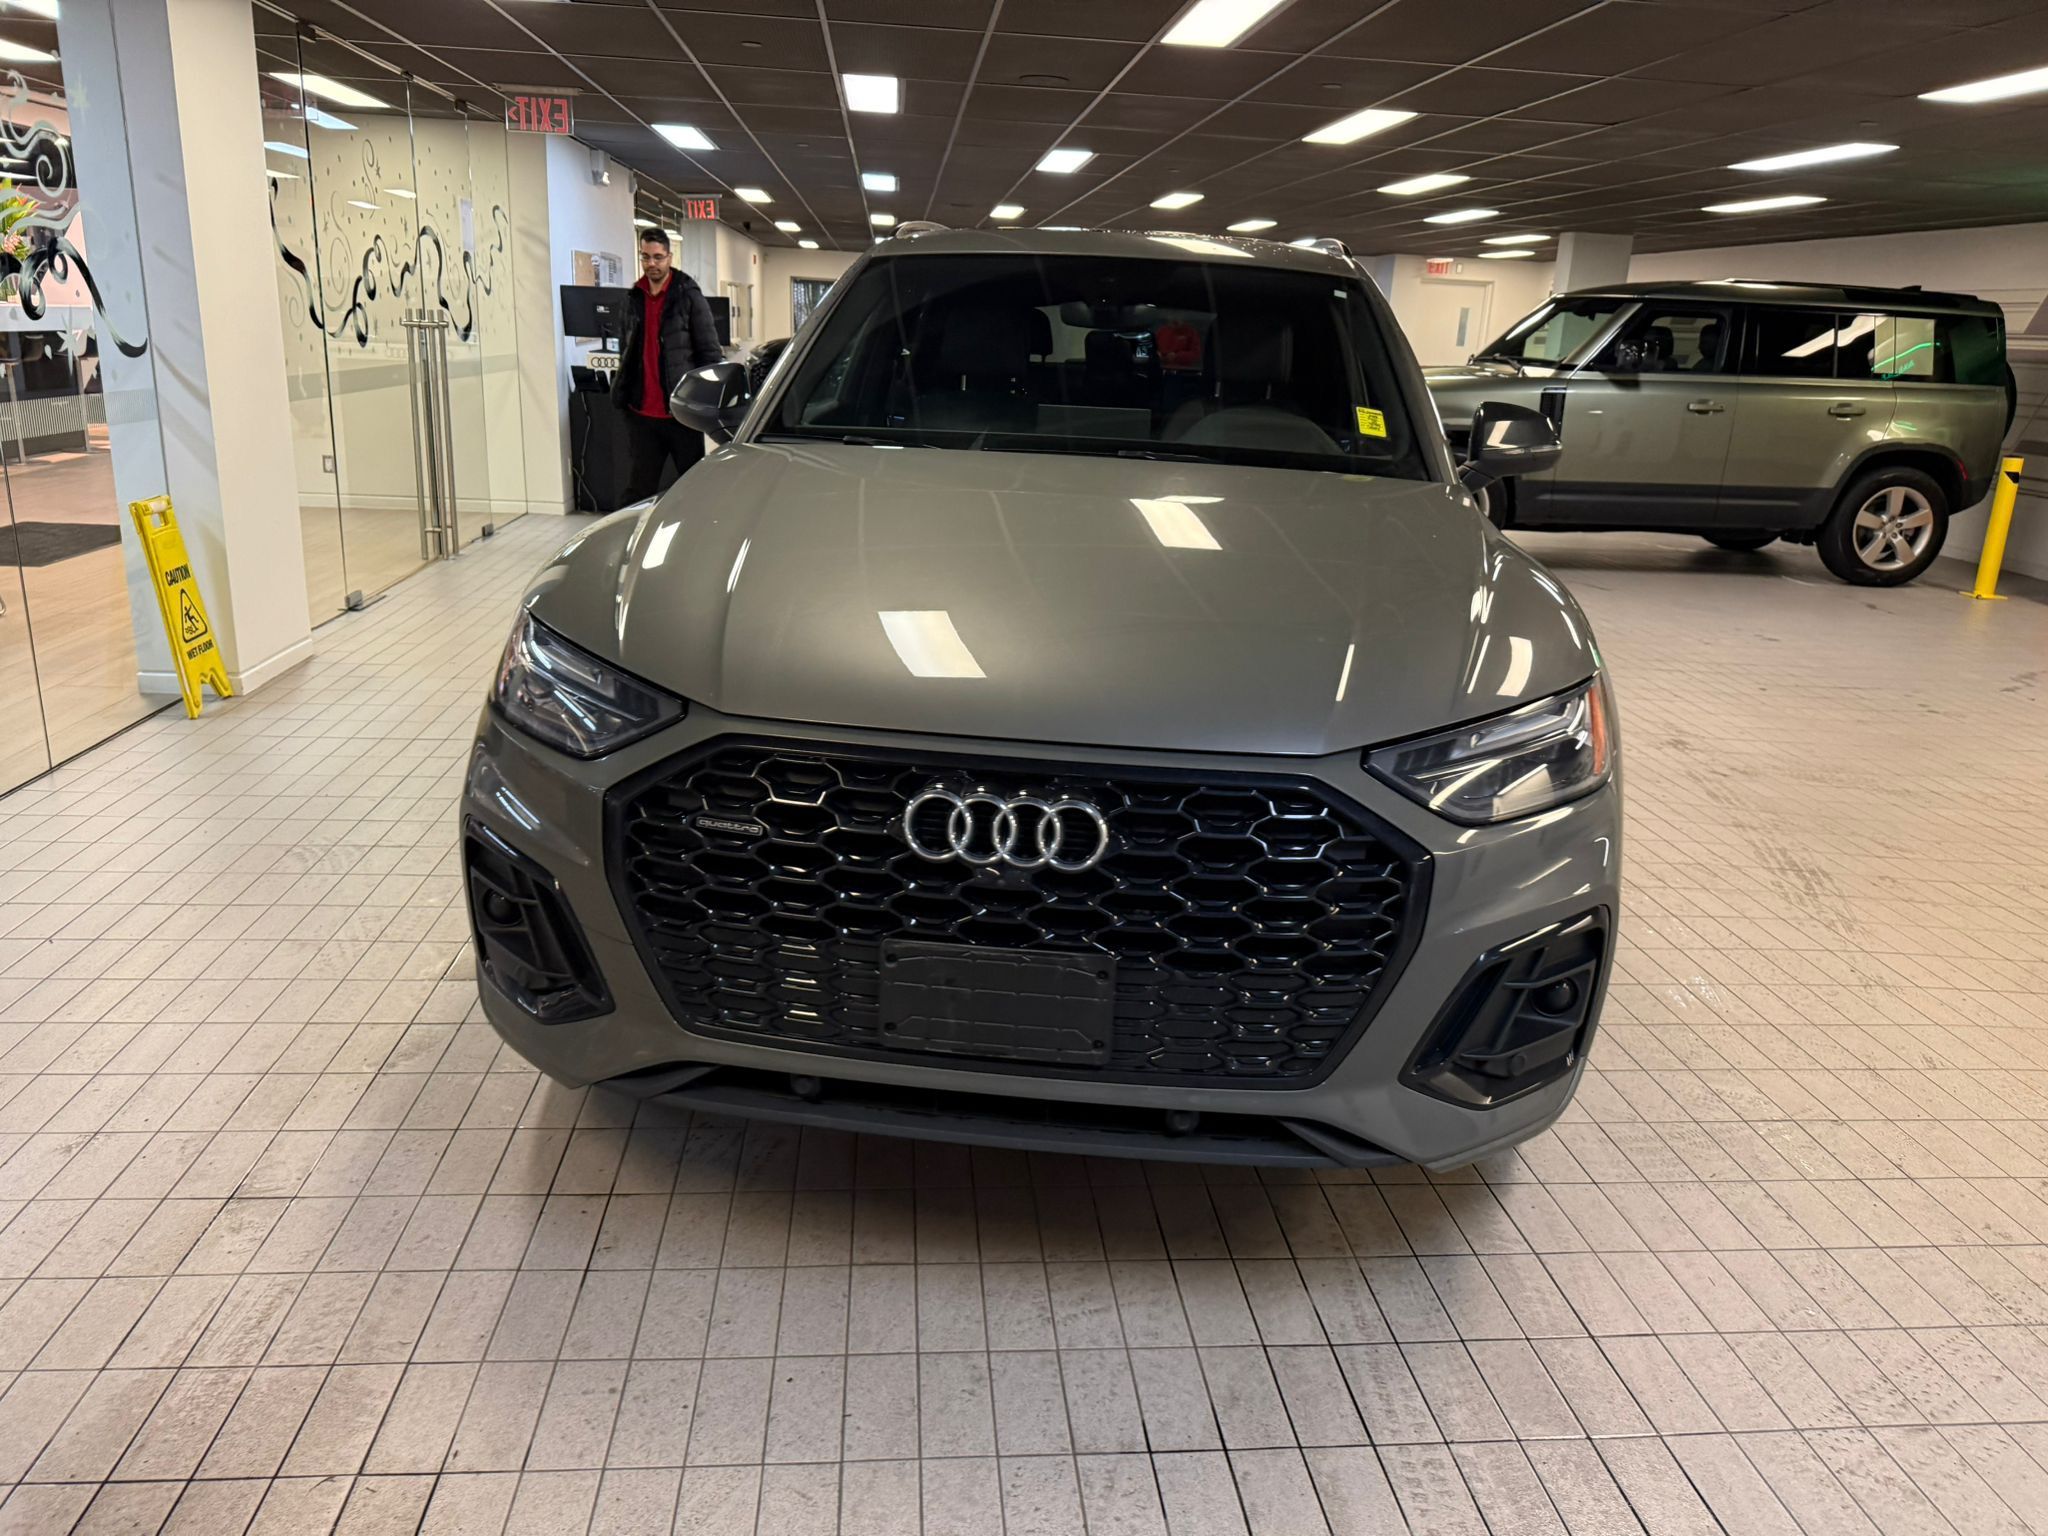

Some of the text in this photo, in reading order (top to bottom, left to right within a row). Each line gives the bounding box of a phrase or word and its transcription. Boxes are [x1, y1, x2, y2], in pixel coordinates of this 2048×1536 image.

[165, 563, 191, 587] CAUTION
[186, 638, 214, 660] WET FLOOR
[699, 819, 759, 833] quattro
